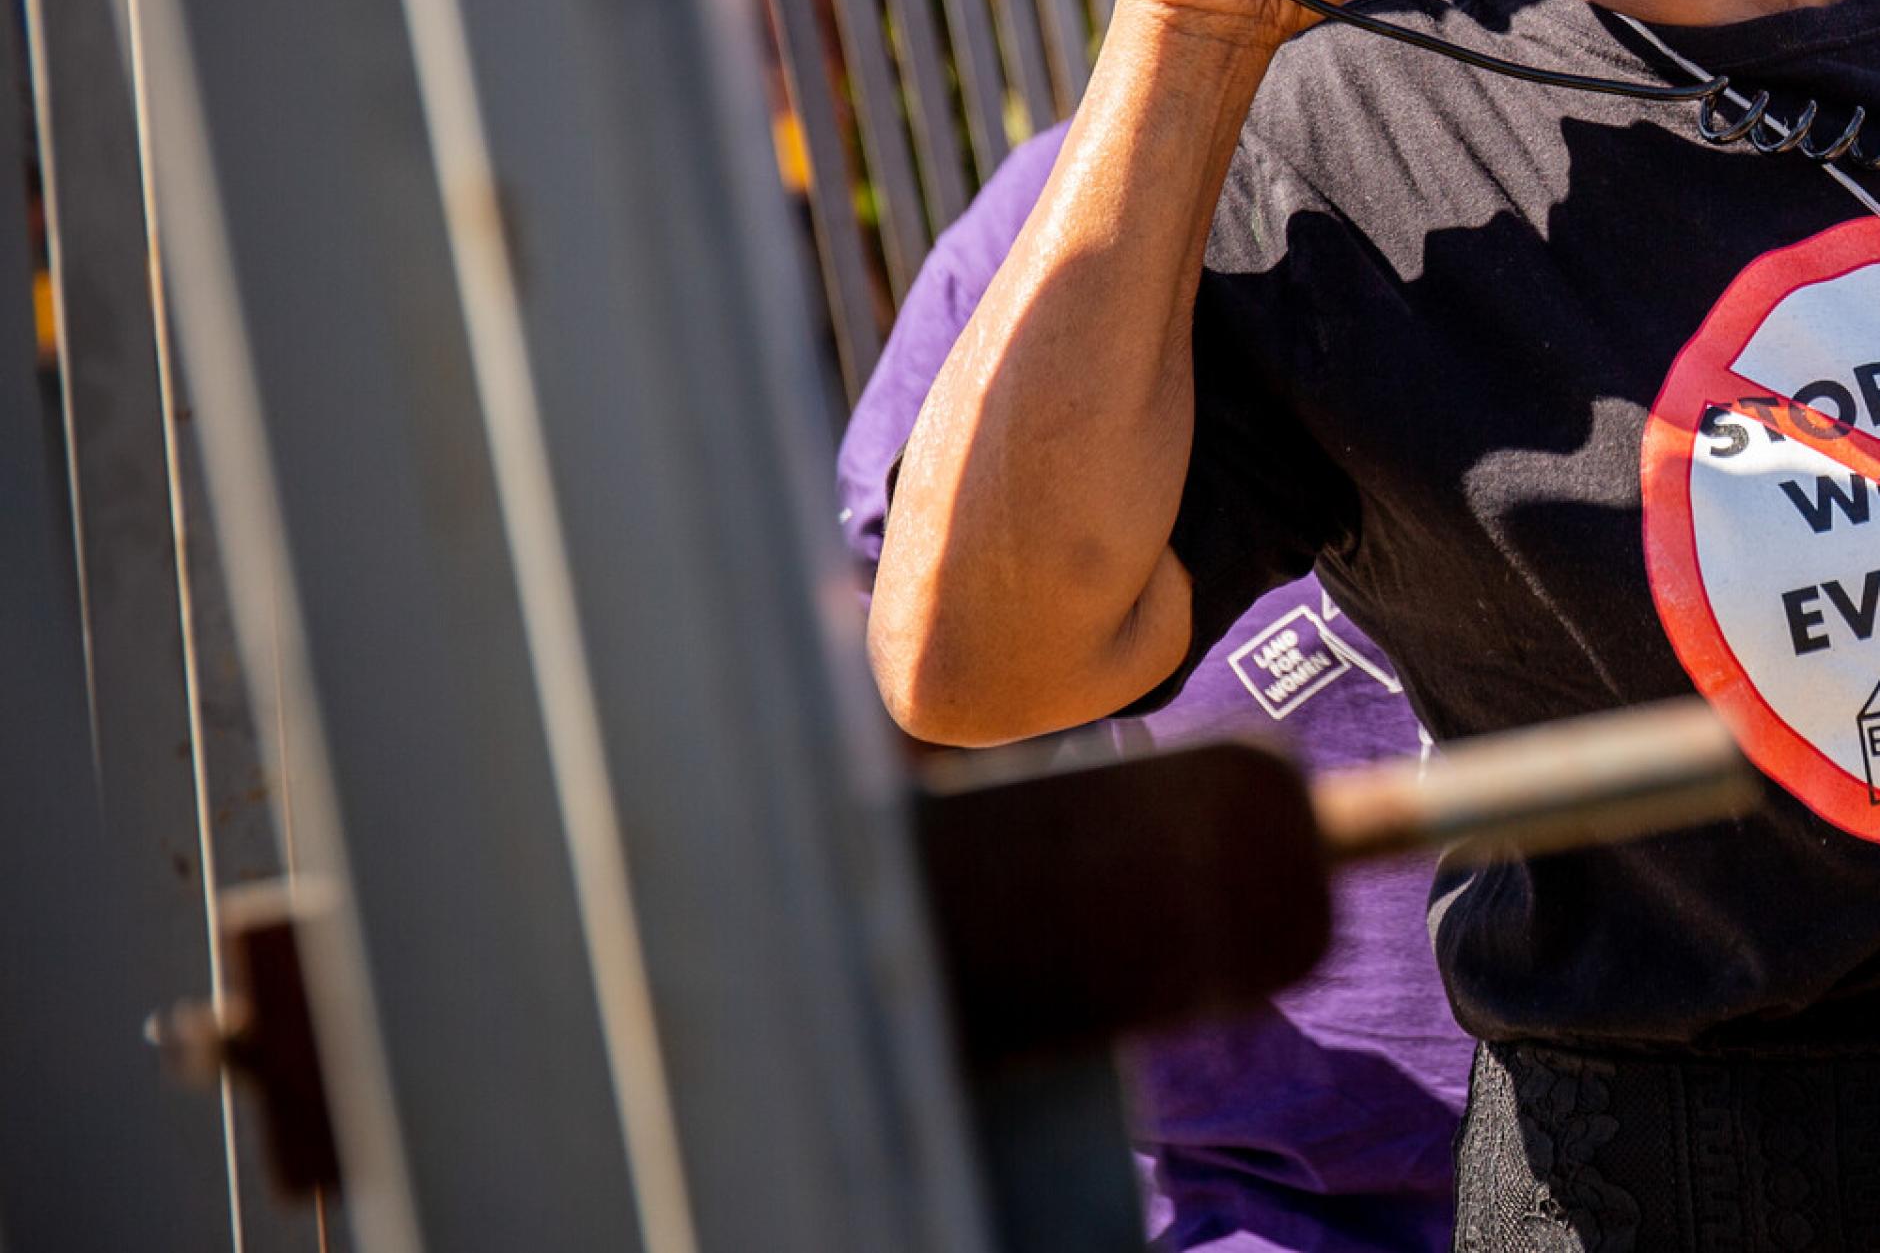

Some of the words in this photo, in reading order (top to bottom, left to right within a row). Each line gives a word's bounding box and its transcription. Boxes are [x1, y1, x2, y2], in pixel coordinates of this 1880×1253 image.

[1254, 628, 1299, 669] LAND
[1268, 648, 1304, 679] FOR
[1263, 650, 1332, 703] WOMEN
